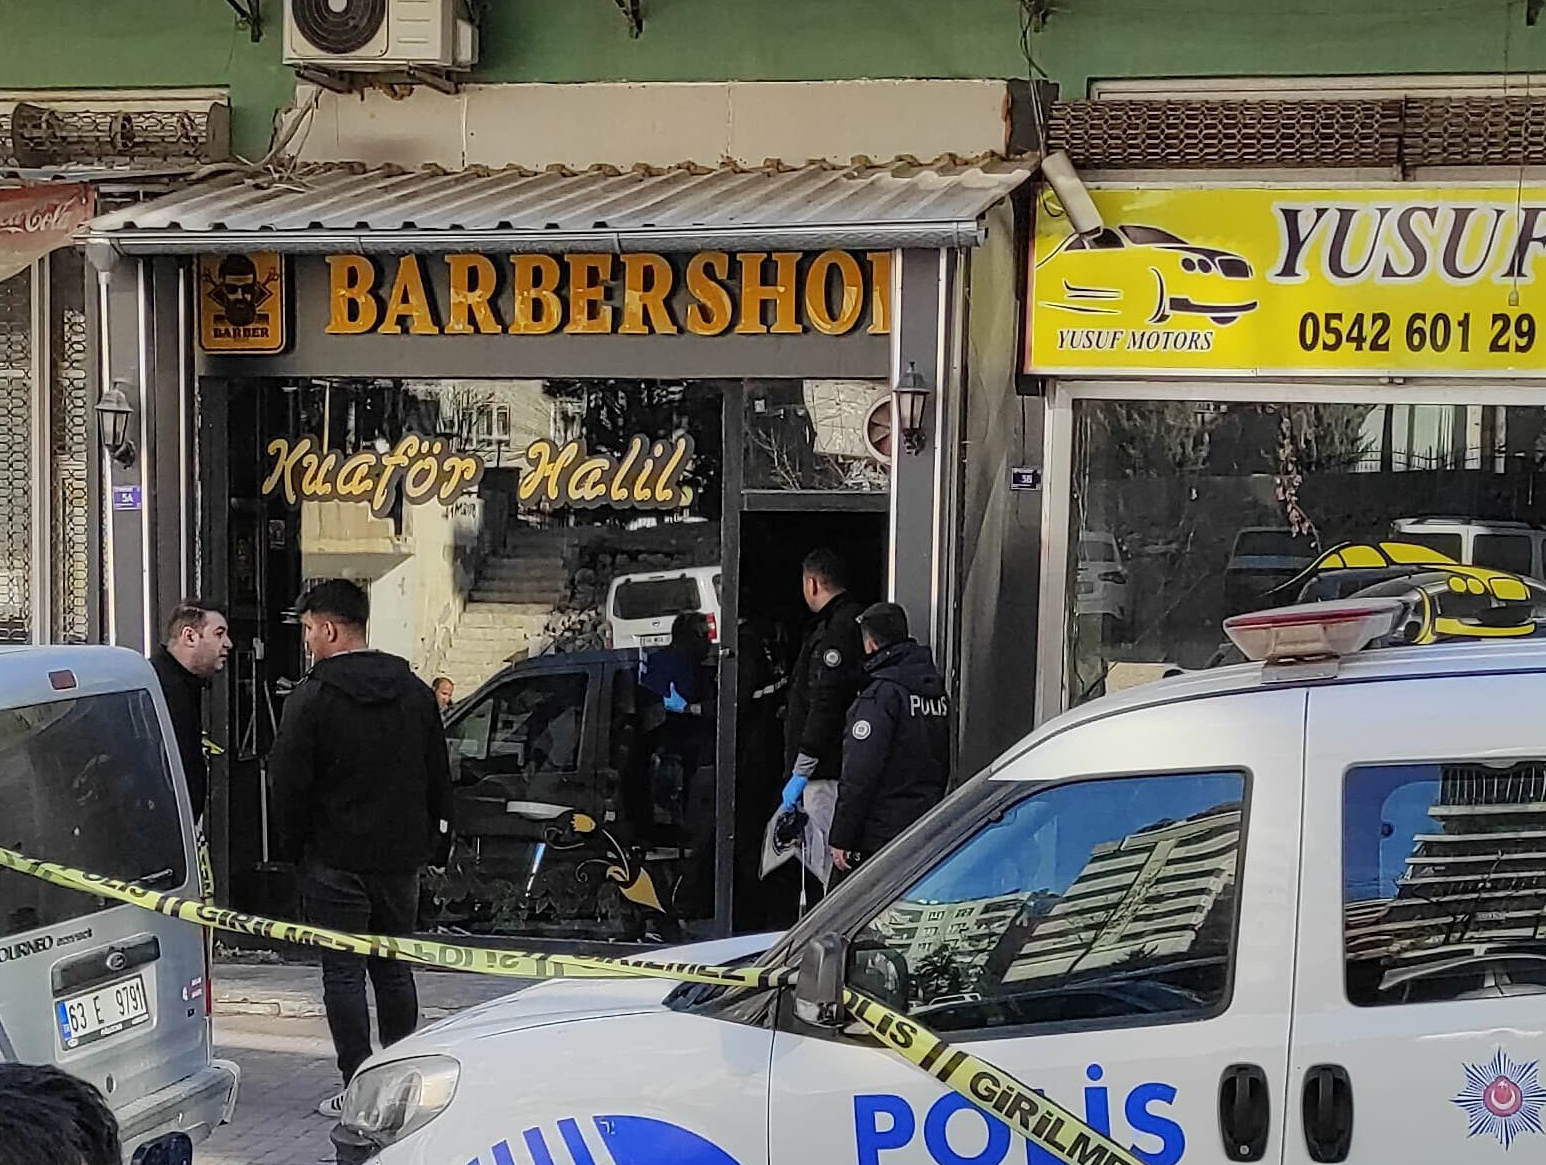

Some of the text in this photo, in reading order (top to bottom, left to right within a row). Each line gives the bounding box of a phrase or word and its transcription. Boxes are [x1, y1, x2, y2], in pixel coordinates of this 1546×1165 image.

[213, 327, 270, 338] BARBER
[1059, 330, 1214, 350] YUSUF MOTORS
[1299, 312, 1391, 353] 0542
[1404, 312, 1471, 353] 601
[1489, 312, 1536, 353] 29
[261, 434, 686, 512] Kuaför Halil
[121, 492, 134, 503] 5A
[67, 1002, 88, 1032] 63
[93, 995, 105, 1025] E
[115, 982, 145, 1016] 9791
[842, 992, 918, 1049] OLİS
